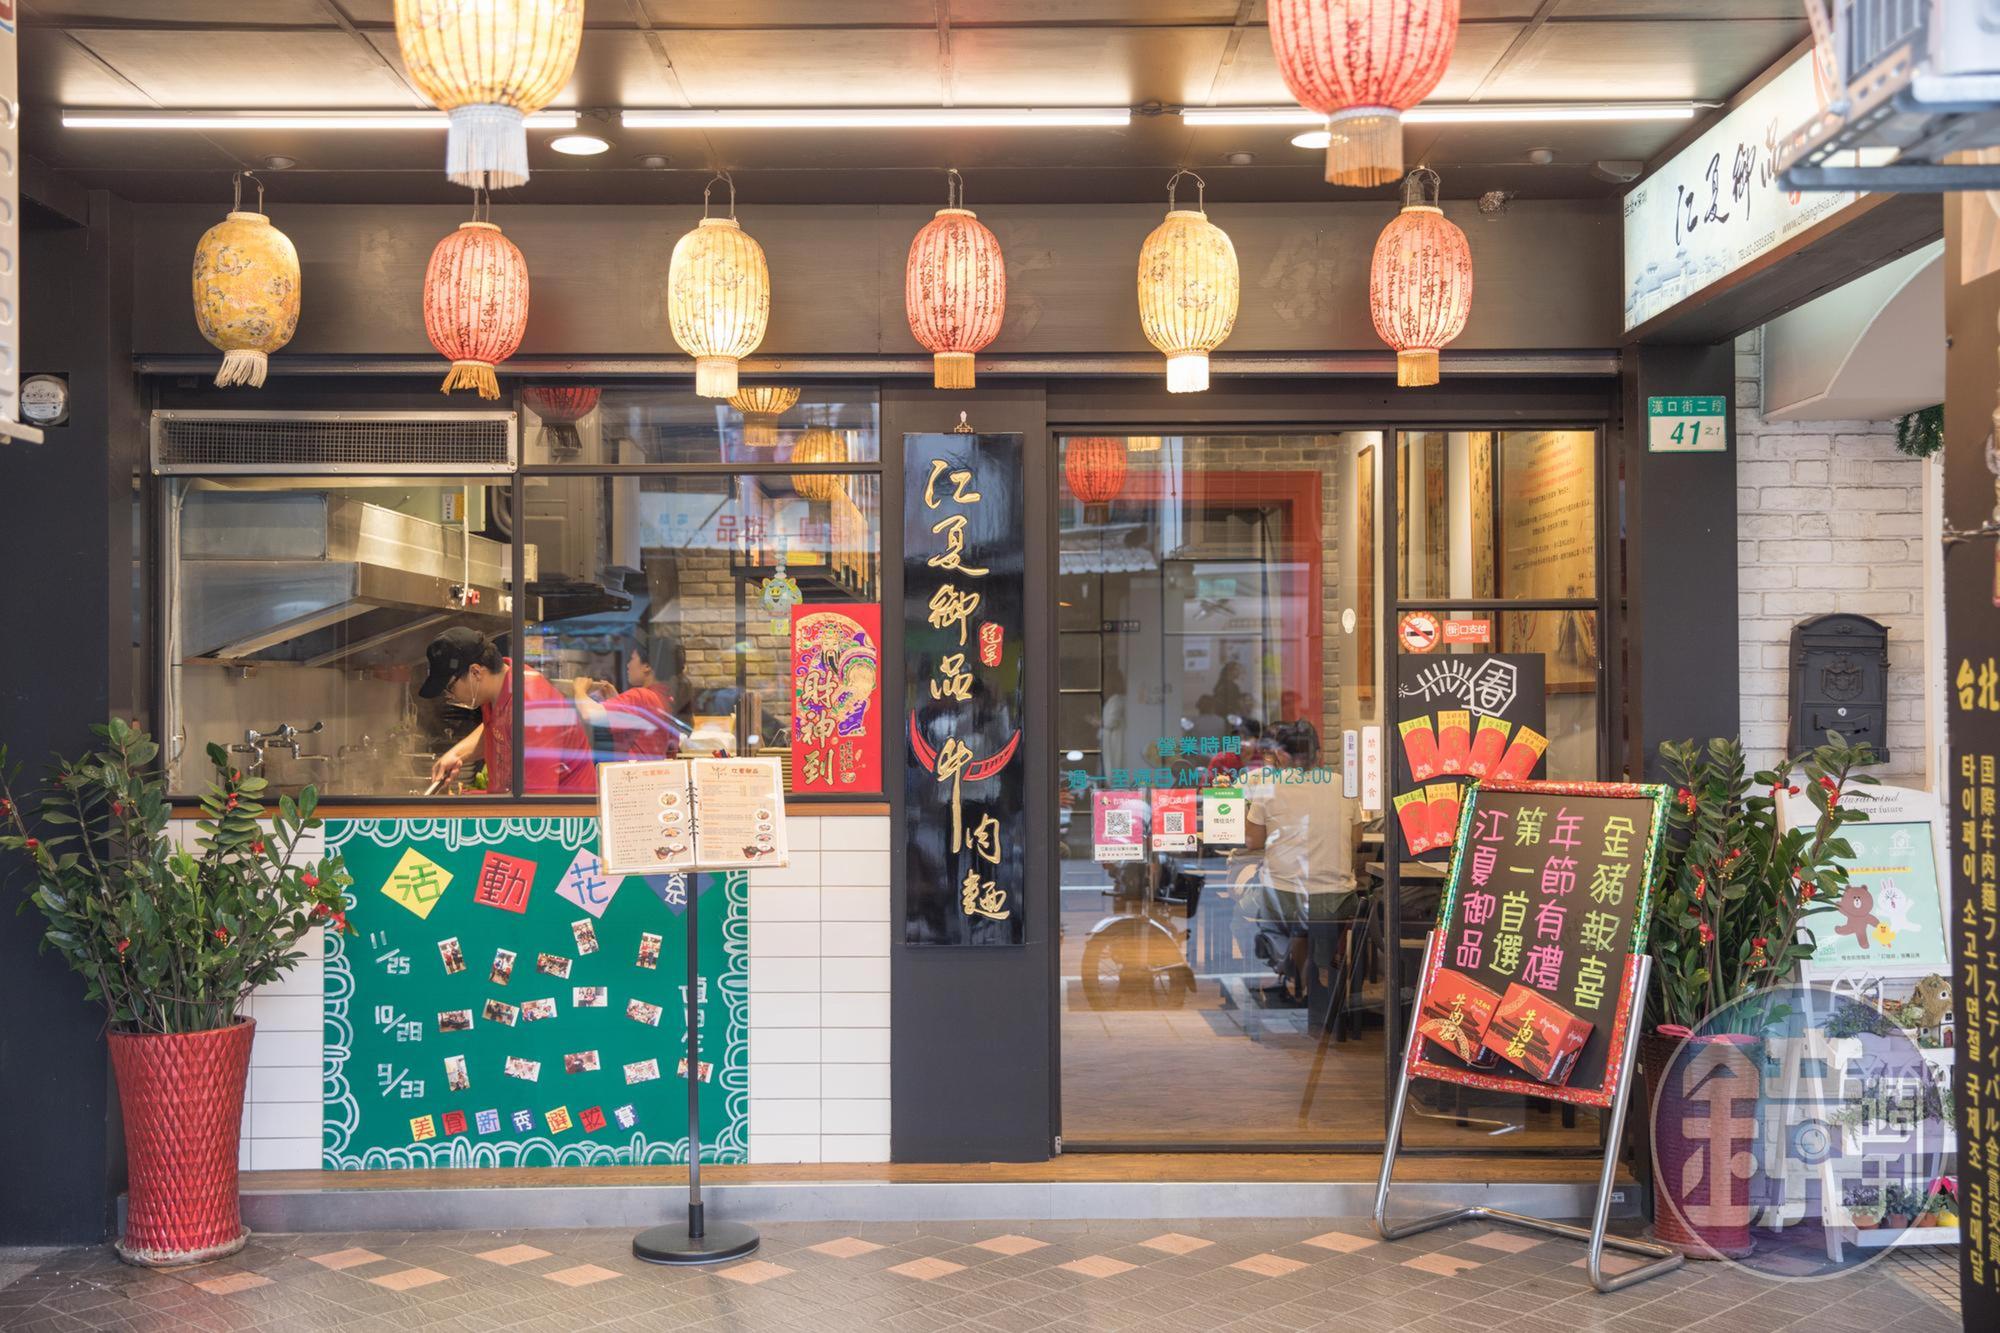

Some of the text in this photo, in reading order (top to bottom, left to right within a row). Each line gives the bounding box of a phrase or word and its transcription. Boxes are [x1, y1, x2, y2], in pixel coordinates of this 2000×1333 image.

[1651, 398, 1723, 414] 漢口街二段
[1670, 421, 1701, 445] 41
[1477, 668, 1512, 710] 春
[1956, 657, 2000, 711] 台北
[801, 670, 839, 786] 財神到
[1157, 736, 1241, 757] 營業時間
[1879, 806, 1904, 814] future
[1456, 809, 1510, 970] 江夏御品
[1488, 806, 1548, 976] 第一首選
[1521, 807, 1585, 992] 年節有禮
[1574, 815, 1637, 1010] 金豬報喜
[370, 930, 411, 975] 11/25
[374, 1005, 424, 1042] 10/28
[377, 1063, 425, 1099] 9/23
